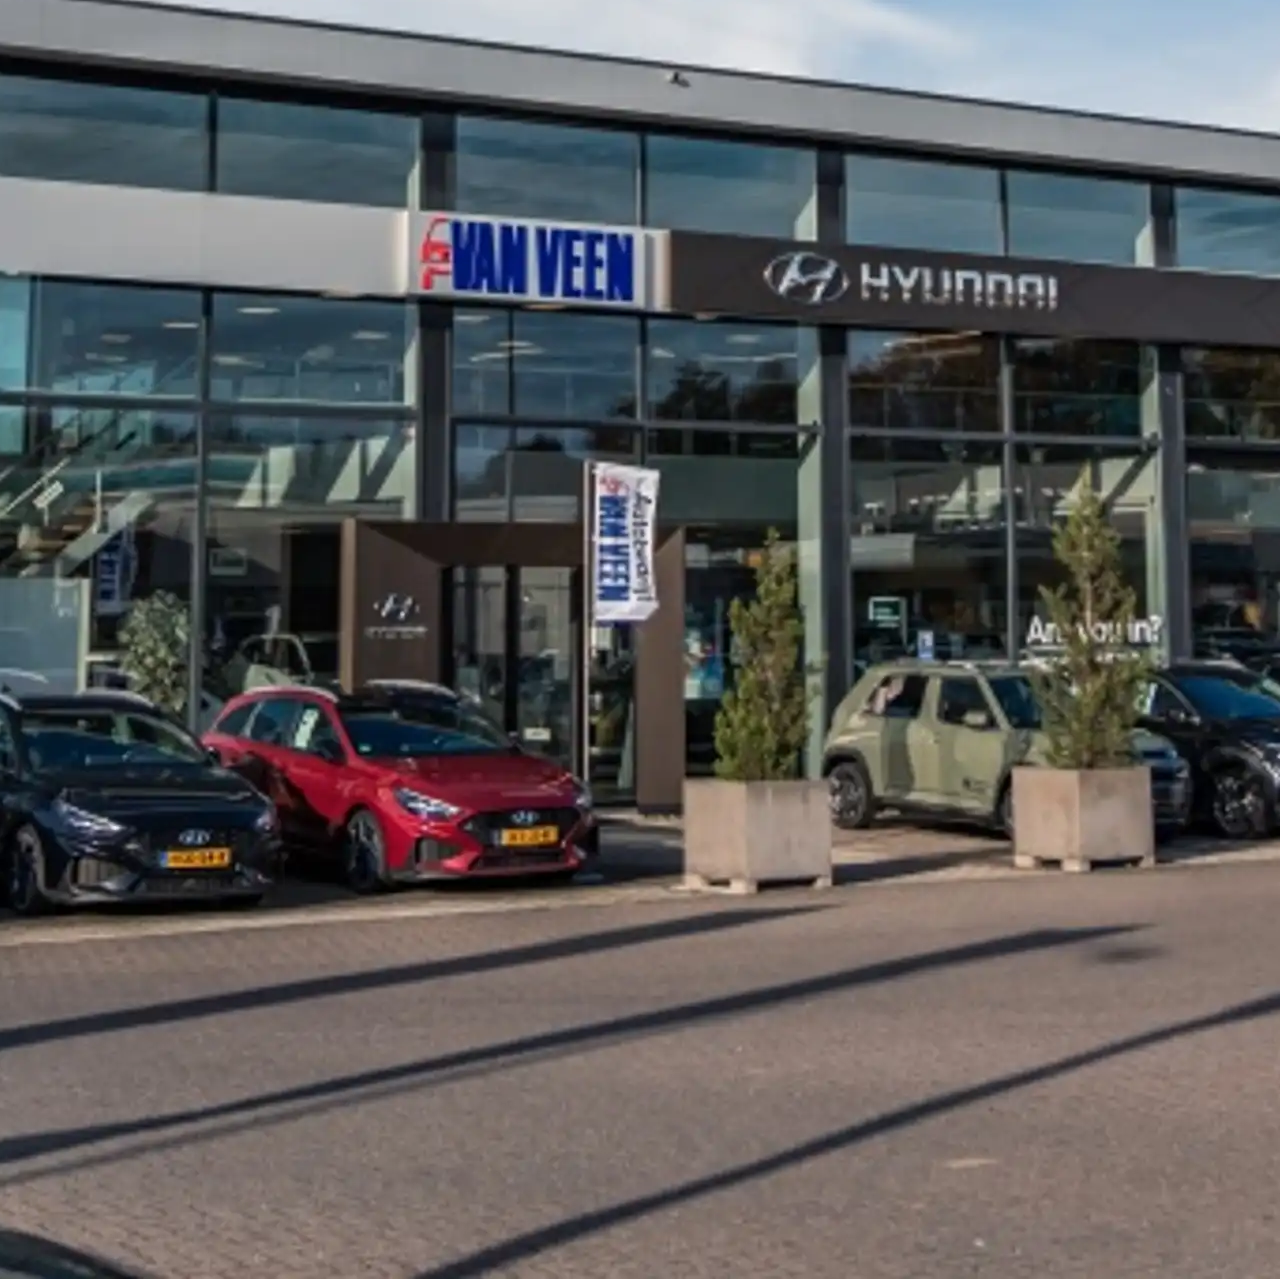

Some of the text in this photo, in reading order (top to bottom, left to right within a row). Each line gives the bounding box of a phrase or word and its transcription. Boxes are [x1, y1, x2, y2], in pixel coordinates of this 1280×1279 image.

[451, 219, 634, 302] VAN VEEN
[860, 262, 1059, 310] HYUNDAI
[598, 495, 630, 601] VAN VEEN
